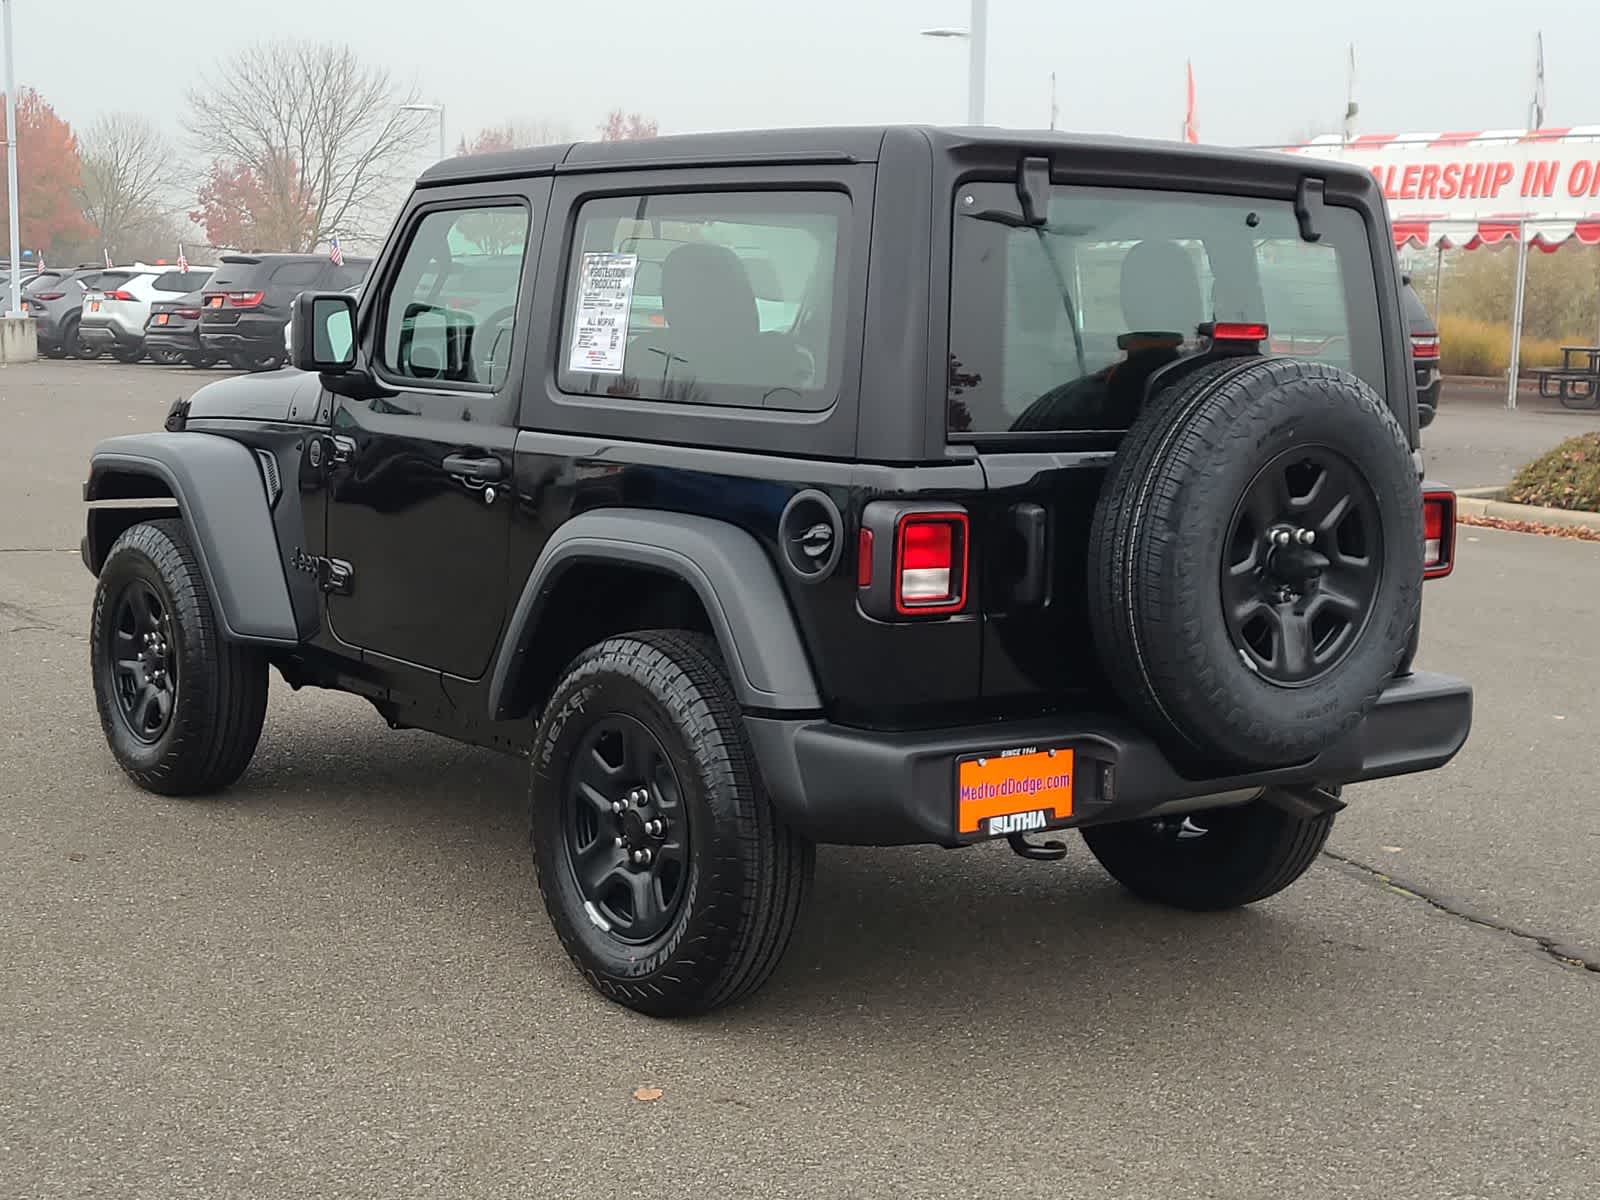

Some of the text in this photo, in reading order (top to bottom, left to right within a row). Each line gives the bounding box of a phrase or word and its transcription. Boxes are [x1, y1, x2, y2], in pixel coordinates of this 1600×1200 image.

[1520, 160, 1560, 197] IN
[1001, 747, 1021, 758] SINCE
[961, 774, 1070, 800] MedfordDodge.com
[1003, 810, 1047, 833] LITHIA
